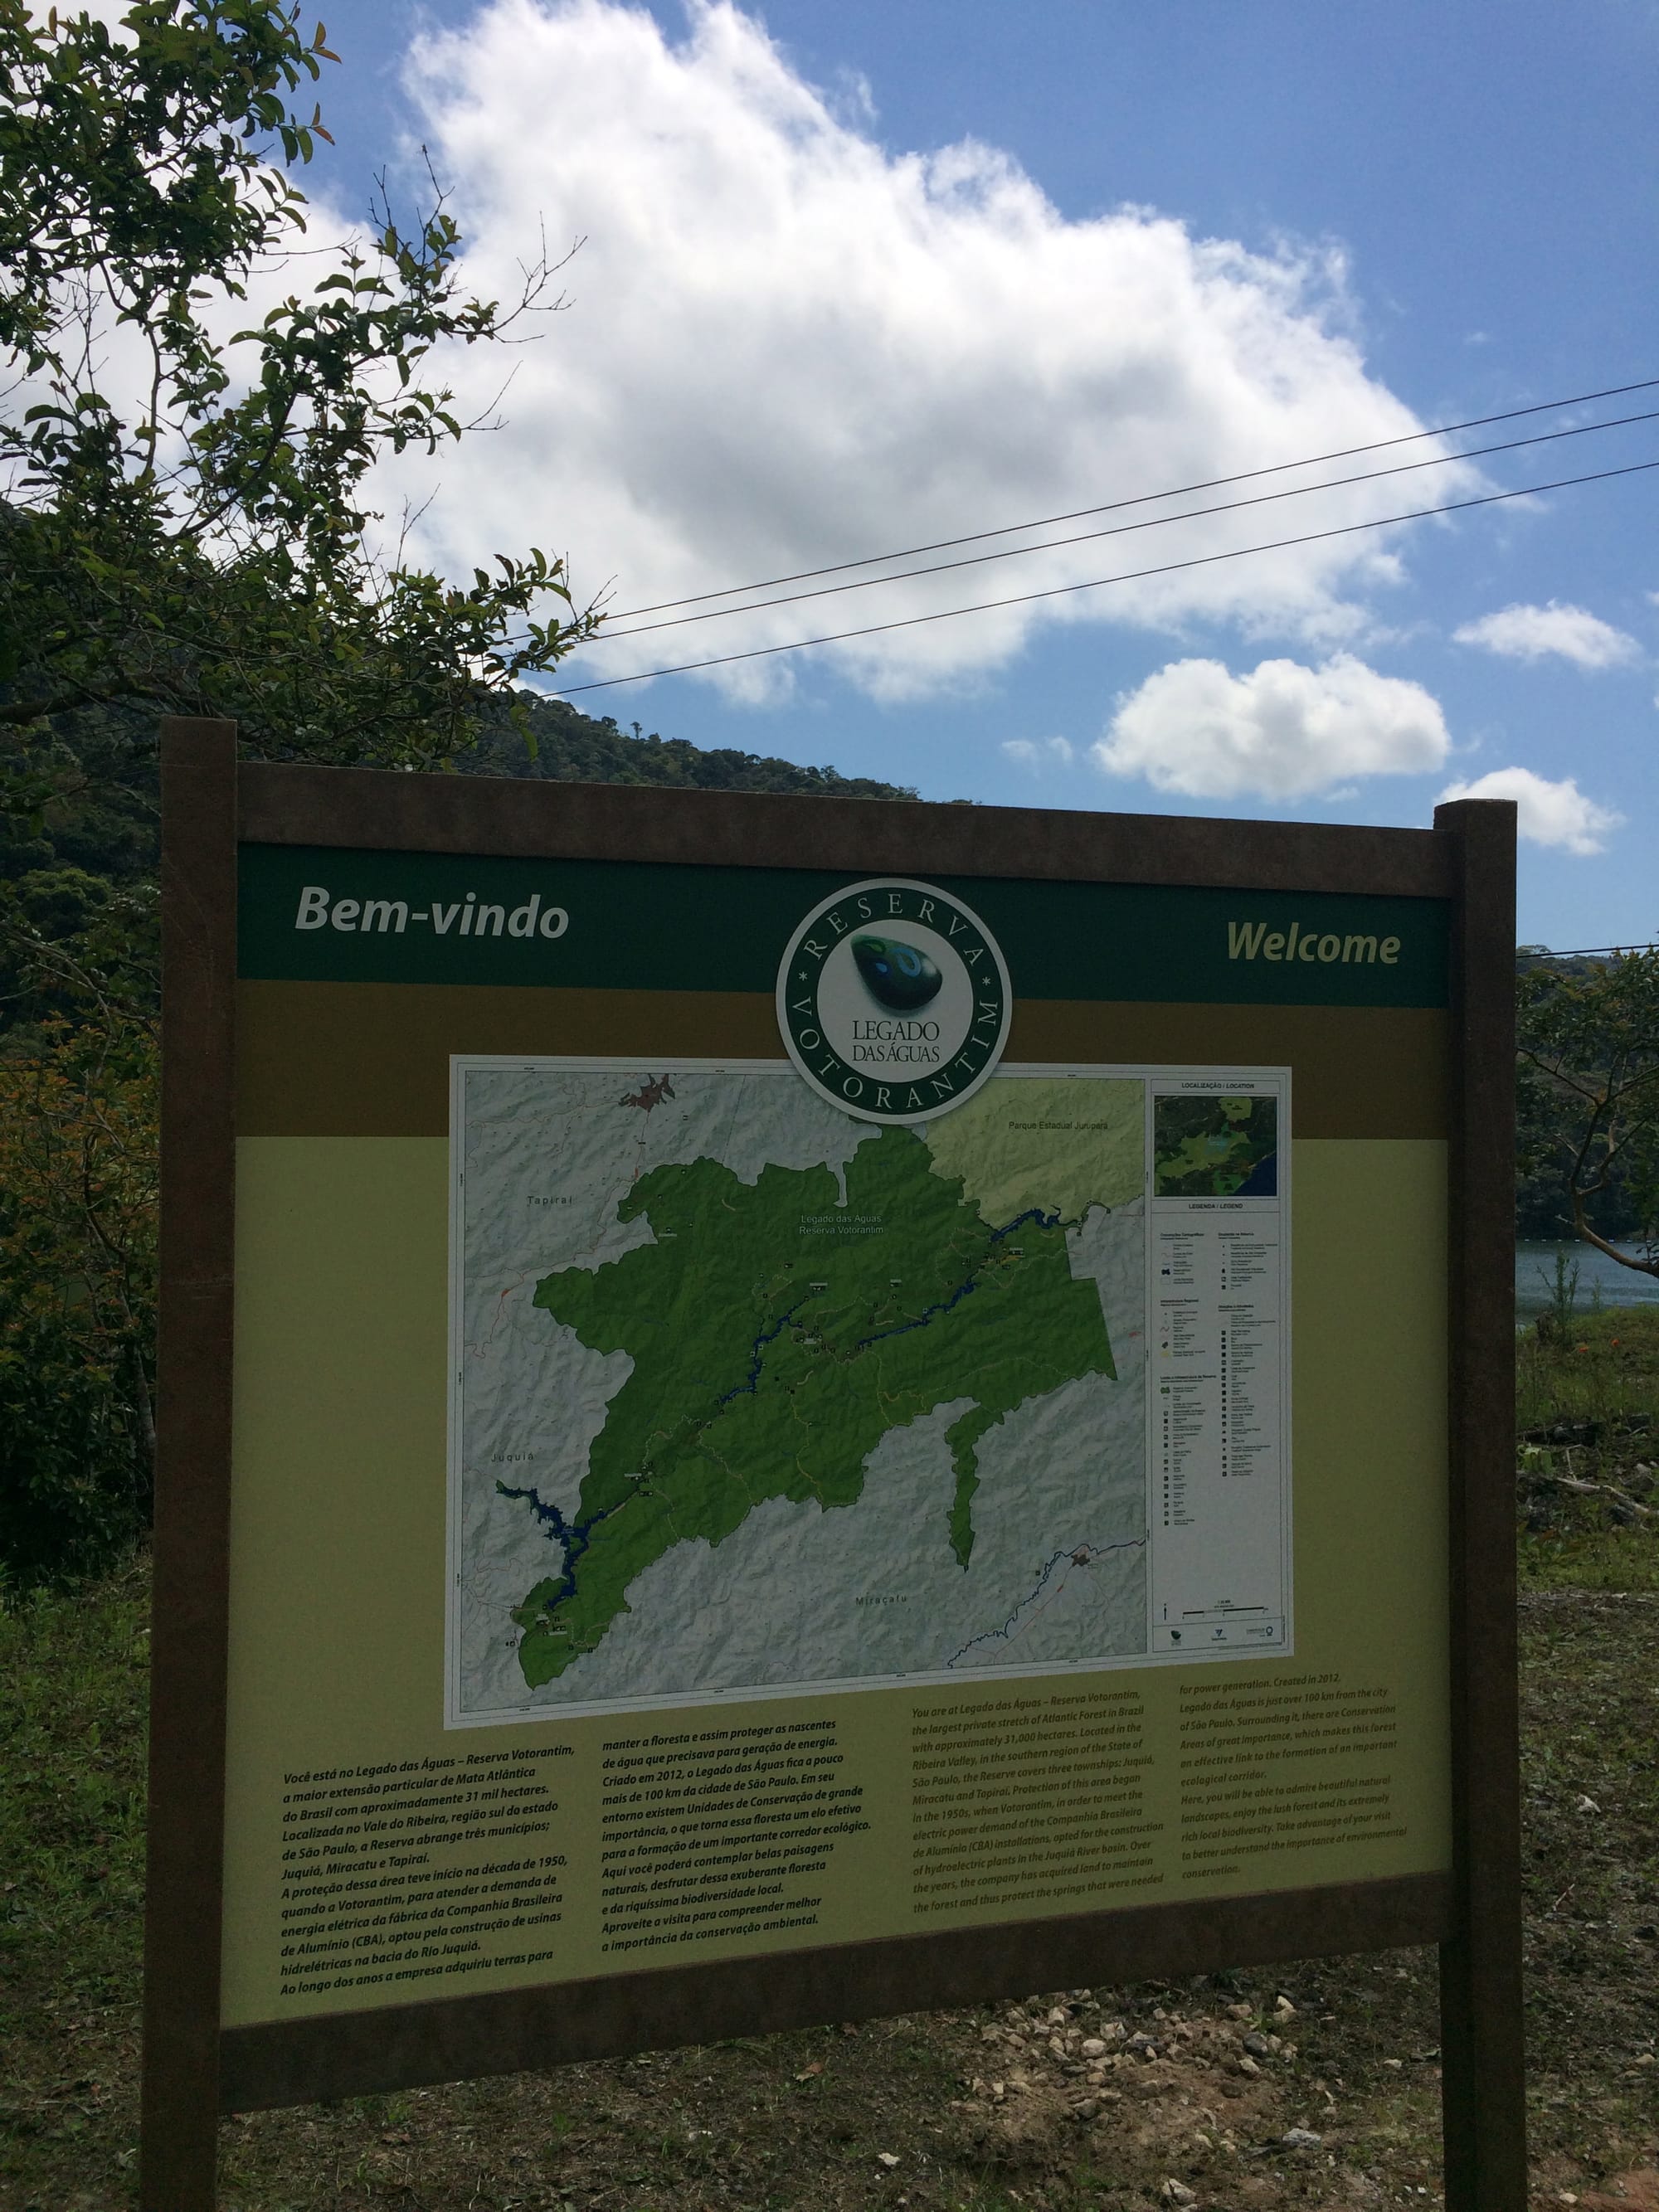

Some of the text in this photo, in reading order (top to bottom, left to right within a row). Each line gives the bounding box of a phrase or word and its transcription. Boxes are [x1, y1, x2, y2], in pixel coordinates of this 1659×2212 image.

[294, 886, 569, 939] Bem-vindo
[804, 893, 984, 966] RESERVA
[1228, 921, 1401, 965] Welcome
[853, 1020, 940, 1042] LEGADO
[792, 997, 998, 1109] VOTORANTIM
[853, 1042, 941, 1062] DAS ÁGUAS
[1009, 1121, 1037, 1130] Parque
[1039, 1121, 1073, 1130] Estadual
[799, 1226, 884, 1235] Reserva Votorantim
[801, 1214, 834, 1225] Legado
[836, 1214, 852, 1223] das
[602, 1739, 641, 1751] manter
[642, 1738, 649, 1747] a
[651, 1734, 690, 1746] floresta
[699, 1729, 728, 1741] assim
[730, 1727, 774, 1741] proteger
[775, 1725, 786, 1733] as
[788, 1721, 836, 1733] nascentes
[912, 1705, 1144, 1736] the largest private stretch of Atlantic Forest in Brazil
[602, 1736, 838, 1769] de água que precisava para geração de energia.
[912, 1742, 933, 1753] with
[935, 1735, 1003, 1753] approximately
[1004, 1732, 1036, 1744] 31,000
[1079, 1724, 1116, 1737] Located
[1117, 1724, 1126, 1733] in
[1126, 1723, 1141, 1733] the
[284, 1771, 311, 1784] Você
[313, 1768, 337, 1782] está
[338, 1769, 354, 1778] no
[356, 1762, 397, 1778] Legado
[399, 1761, 419, 1772] das
[421, 1757, 455, 1772] Águas
[466, 1753, 509, 1765] Reserva
[512, 1745, 575, 1760] Votorantim,
[602, 1755, 844, 1787] Criado em 2012, o Legado das Águas fica a pouco
[283, 1767, 536, 1803] a maior extensão particular de Mata Atlântica
[602, 1773, 834, 1806] mais de 100 km da cidade de São Paulo. Em seu
[283, 1786, 549, 1822] do Brasil com aproximadamente 31 mil hectares.
[602, 1785, 864, 1824] entorno existem Unidades de Conservação de grande
[282, 1801, 558, 1842] Localizada no Vale do Ribeira, região sul do estado
[282, 1850, 296, 1861] de
[299, 1847, 320, 1859] São
[323, 1842, 358, 1856] Paulo,
[360, 1843, 368, 1851] a
[370, 1838, 415, 1850] Reserva
[416, 1832, 463, 1845] abrange
[465, 1827, 486, 1840] três
[281, 1855, 567, 1901] A proteção dessa área teve início na década de 1950,
[326, 1860, 377, 1874] Miracatu
[379, 1860, 387, 1869] e
